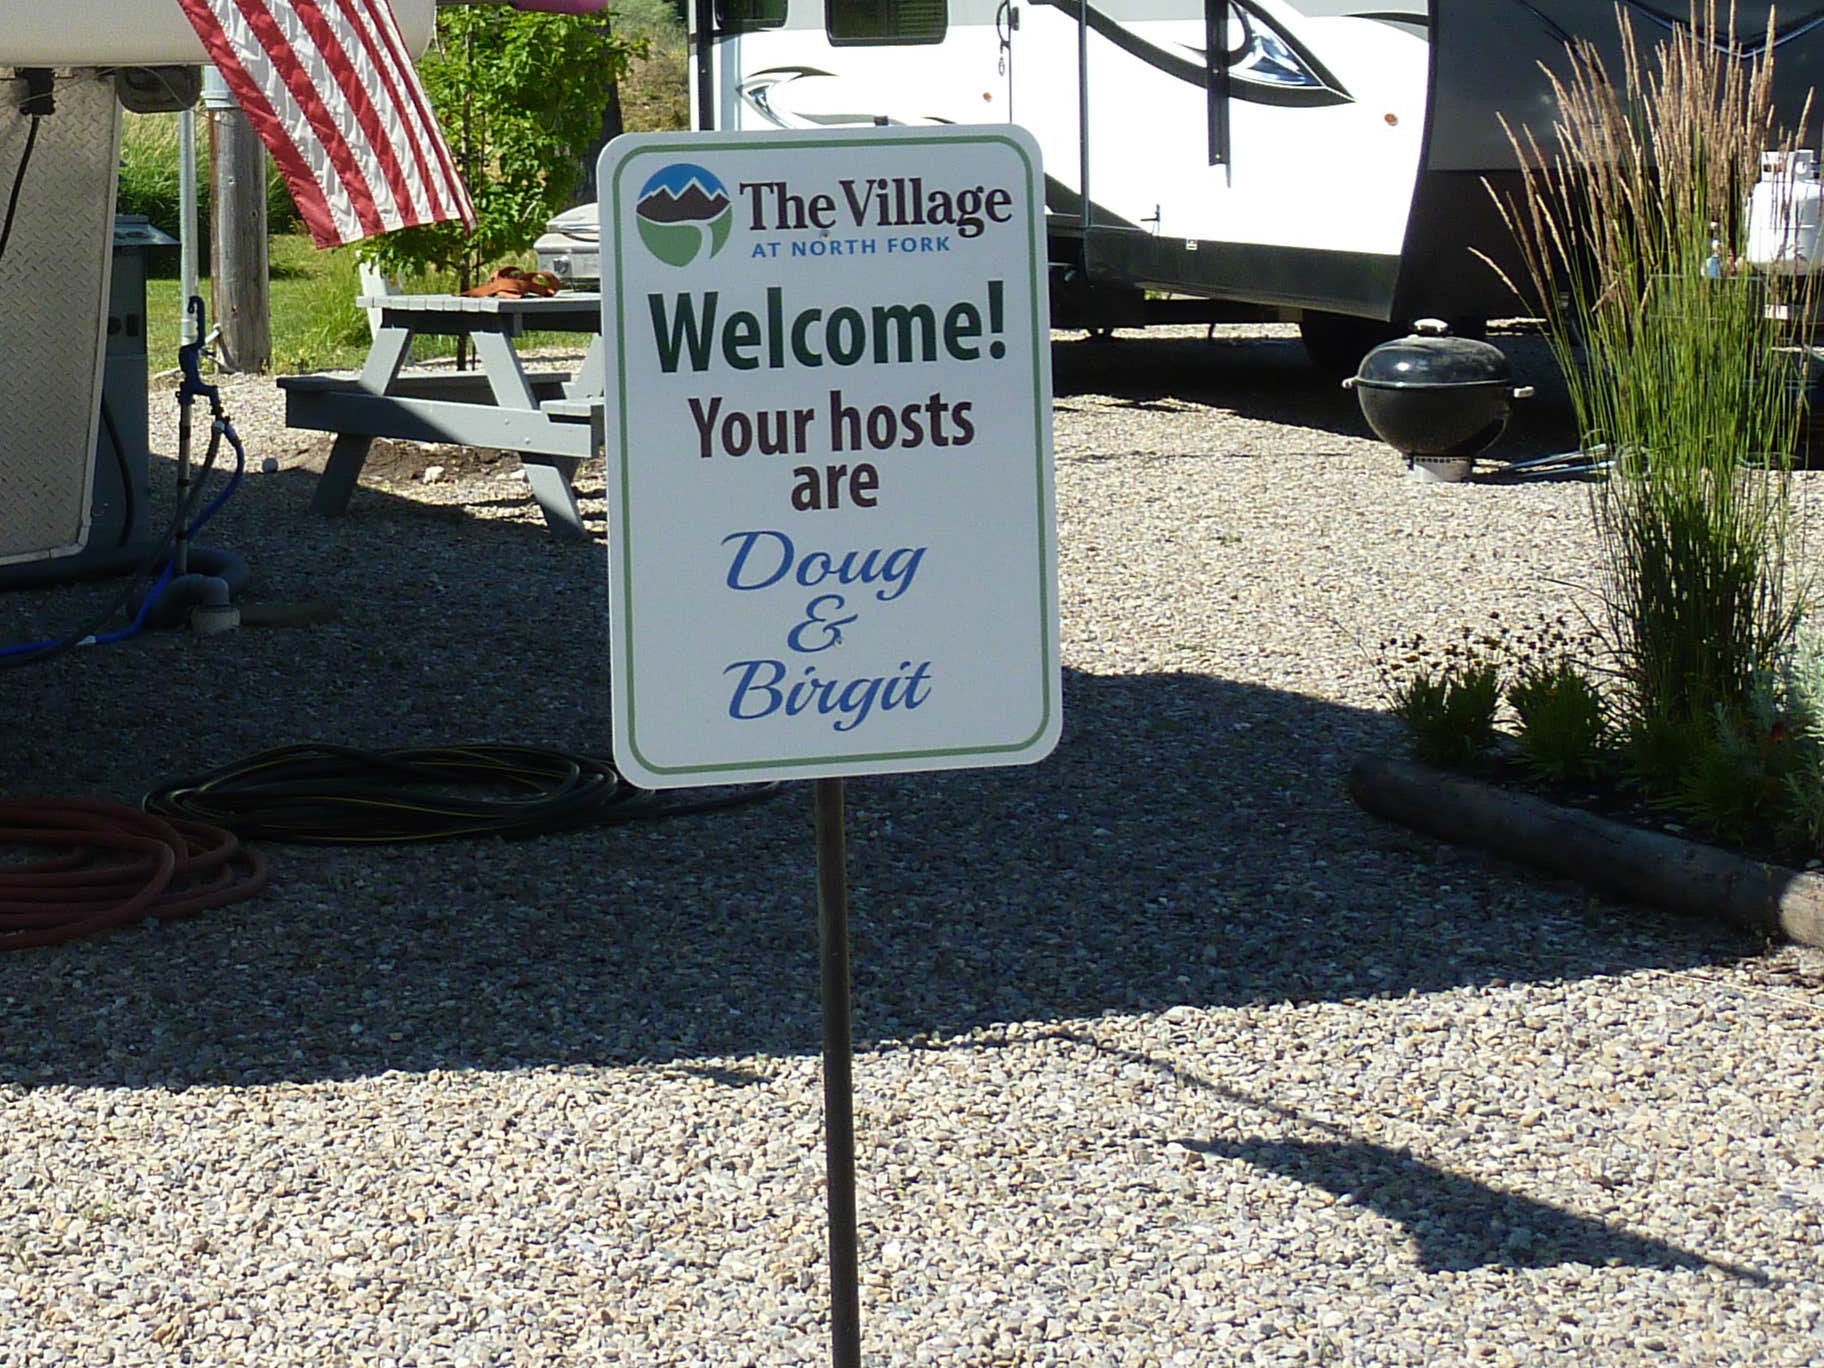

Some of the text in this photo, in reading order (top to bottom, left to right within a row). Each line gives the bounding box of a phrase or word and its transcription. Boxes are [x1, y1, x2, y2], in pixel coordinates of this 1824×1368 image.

[738, 176, 1013, 239] The Village
[751, 235, 951, 259] AT NORTH FORK
[647, 280, 1007, 374] Welcome!
[687, 390, 975, 459] Your hosts
[790, 462, 880, 512] are
[721, 530, 928, 602] Doug
[786, 594, 859, 654] &
[722, 659, 932, 732] Birgit
